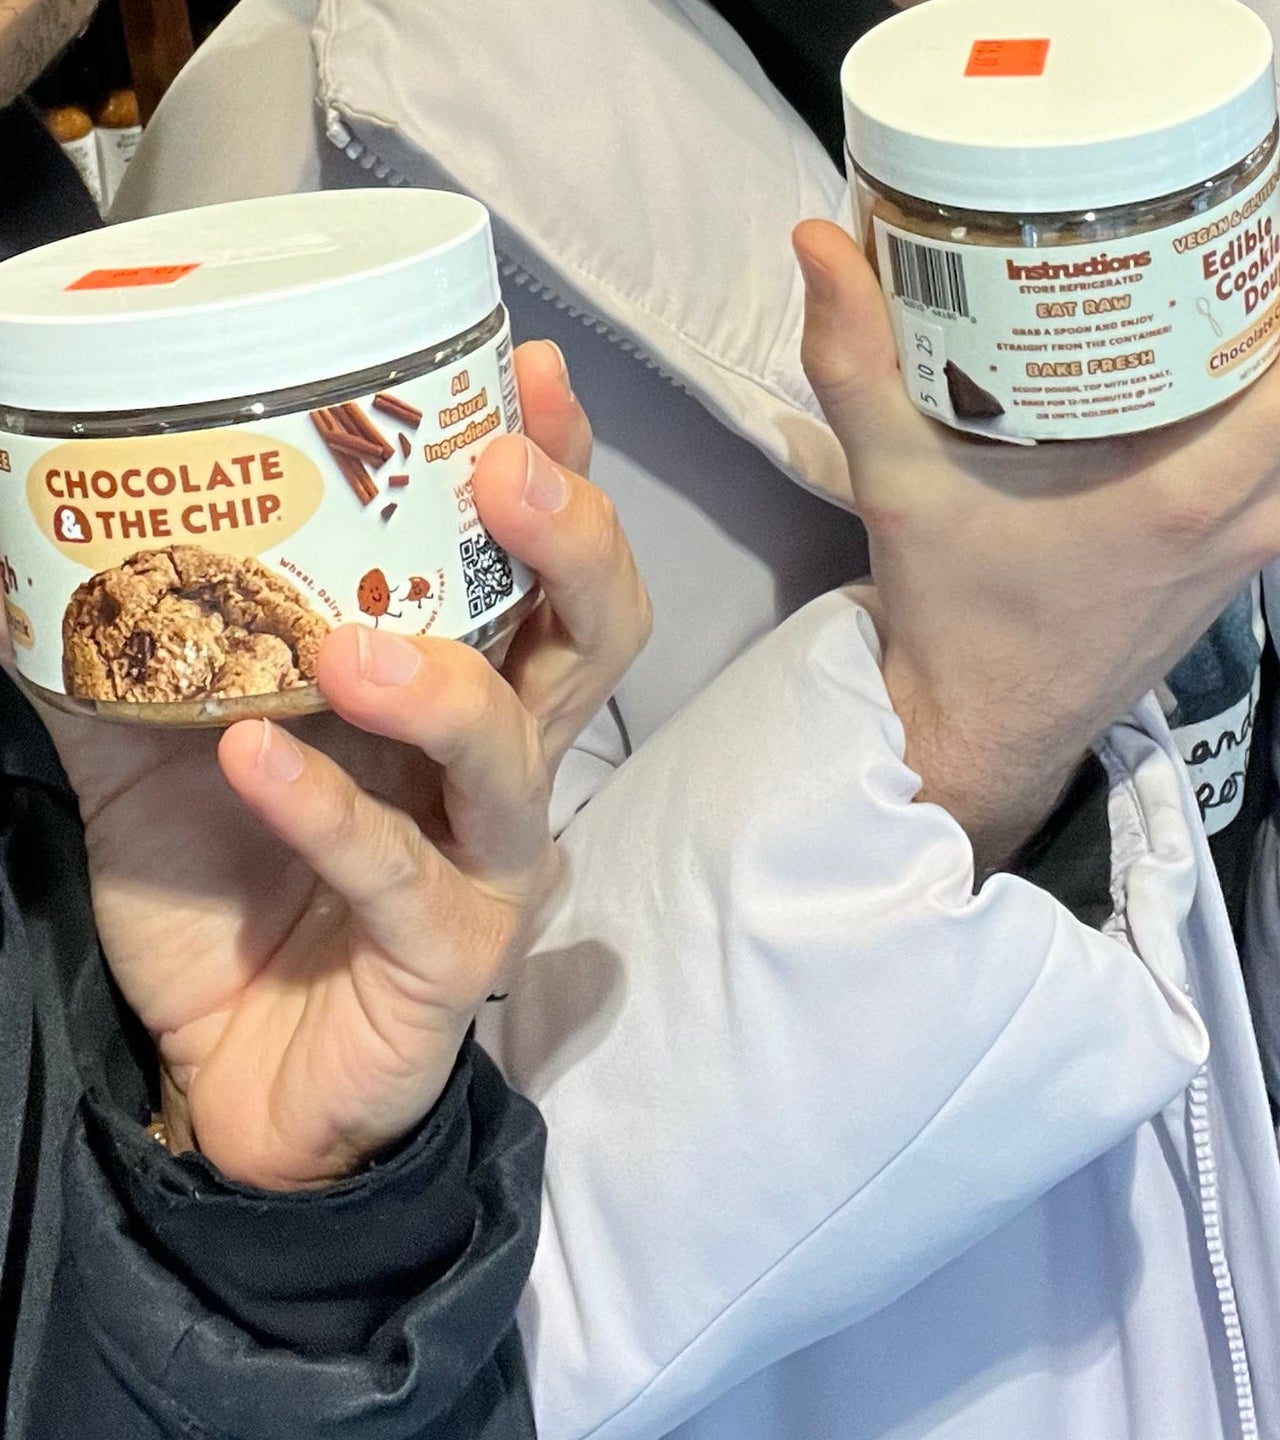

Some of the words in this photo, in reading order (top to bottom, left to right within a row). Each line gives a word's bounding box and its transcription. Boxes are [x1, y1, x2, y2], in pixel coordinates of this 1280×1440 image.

[1172, 215, 1230, 255] VEGAN
[1229, 210, 1243, 228] &
[1202, 215, 1273, 280] Edible
[1005, 250, 1153, 281] Instructions
[1019, 284, 1056, 295] STORE
[1059, 273, 1144, 293] REFRIGERATED
[1035, 301, 1078, 319] EAT
[1082, 293, 1133, 316] RAW
[1011, 327, 1042, 337] GRAB
[1043, 327, 1052, 336] A
[1053, 325, 1093, 336] SPOON
[1094, 322, 1119, 333] AND
[1120, 314, 1154, 329] ENJOY
[996, 342, 1049, 352] STRAIGHT
[1050, 341, 1084, 352] FROM
[1085, 339, 1107, 350] THE
[1209, 316, 1274, 371] Chocolate
[917, 363, 935, 382] 10
[1025, 361, 1083, 378] BAKE
[1087, 348, 1156, 375] FRESH
[450, 368, 470, 397] All
[438, 386, 488, 430] Natural
[920, 391, 938, 407] 5
[45, 449, 284, 500] CHOCOLATE
[95, 508, 172, 540] THE
